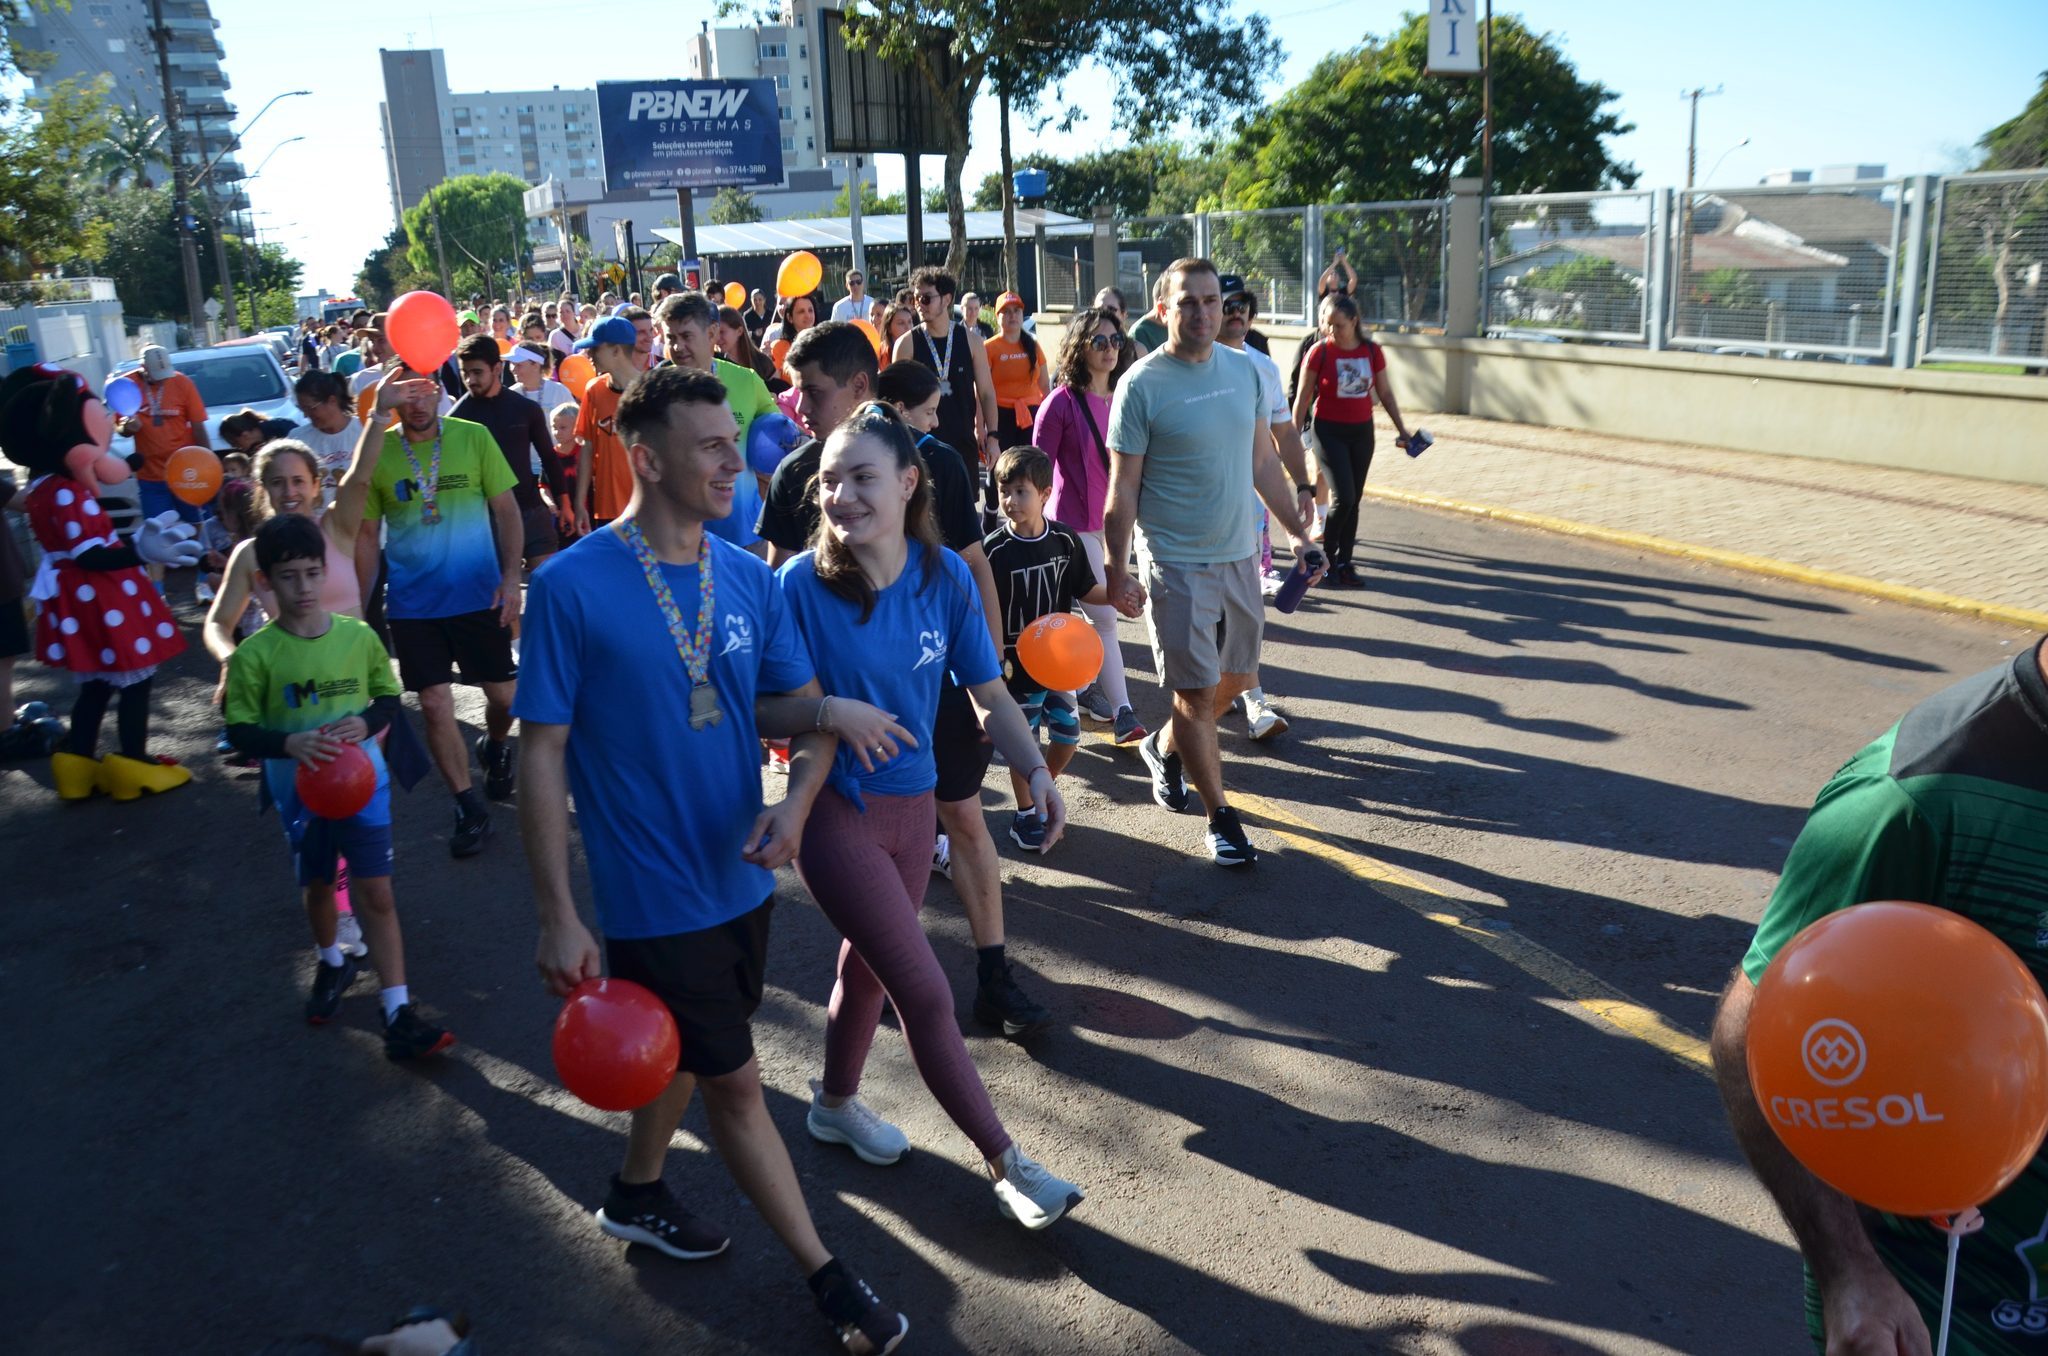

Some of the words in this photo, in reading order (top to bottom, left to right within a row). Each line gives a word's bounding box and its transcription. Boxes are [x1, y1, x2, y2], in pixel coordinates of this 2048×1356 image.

[628, 88, 749, 121] PBNEW
[659, 119, 752, 133] SISTEMAS
[652, 141, 686, 151] Soluções
[686, 139, 733, 150] tecnológicas
[666, 149, 697, 158] produtos
[1770, 1092, 1944, 1130] CRESOL
